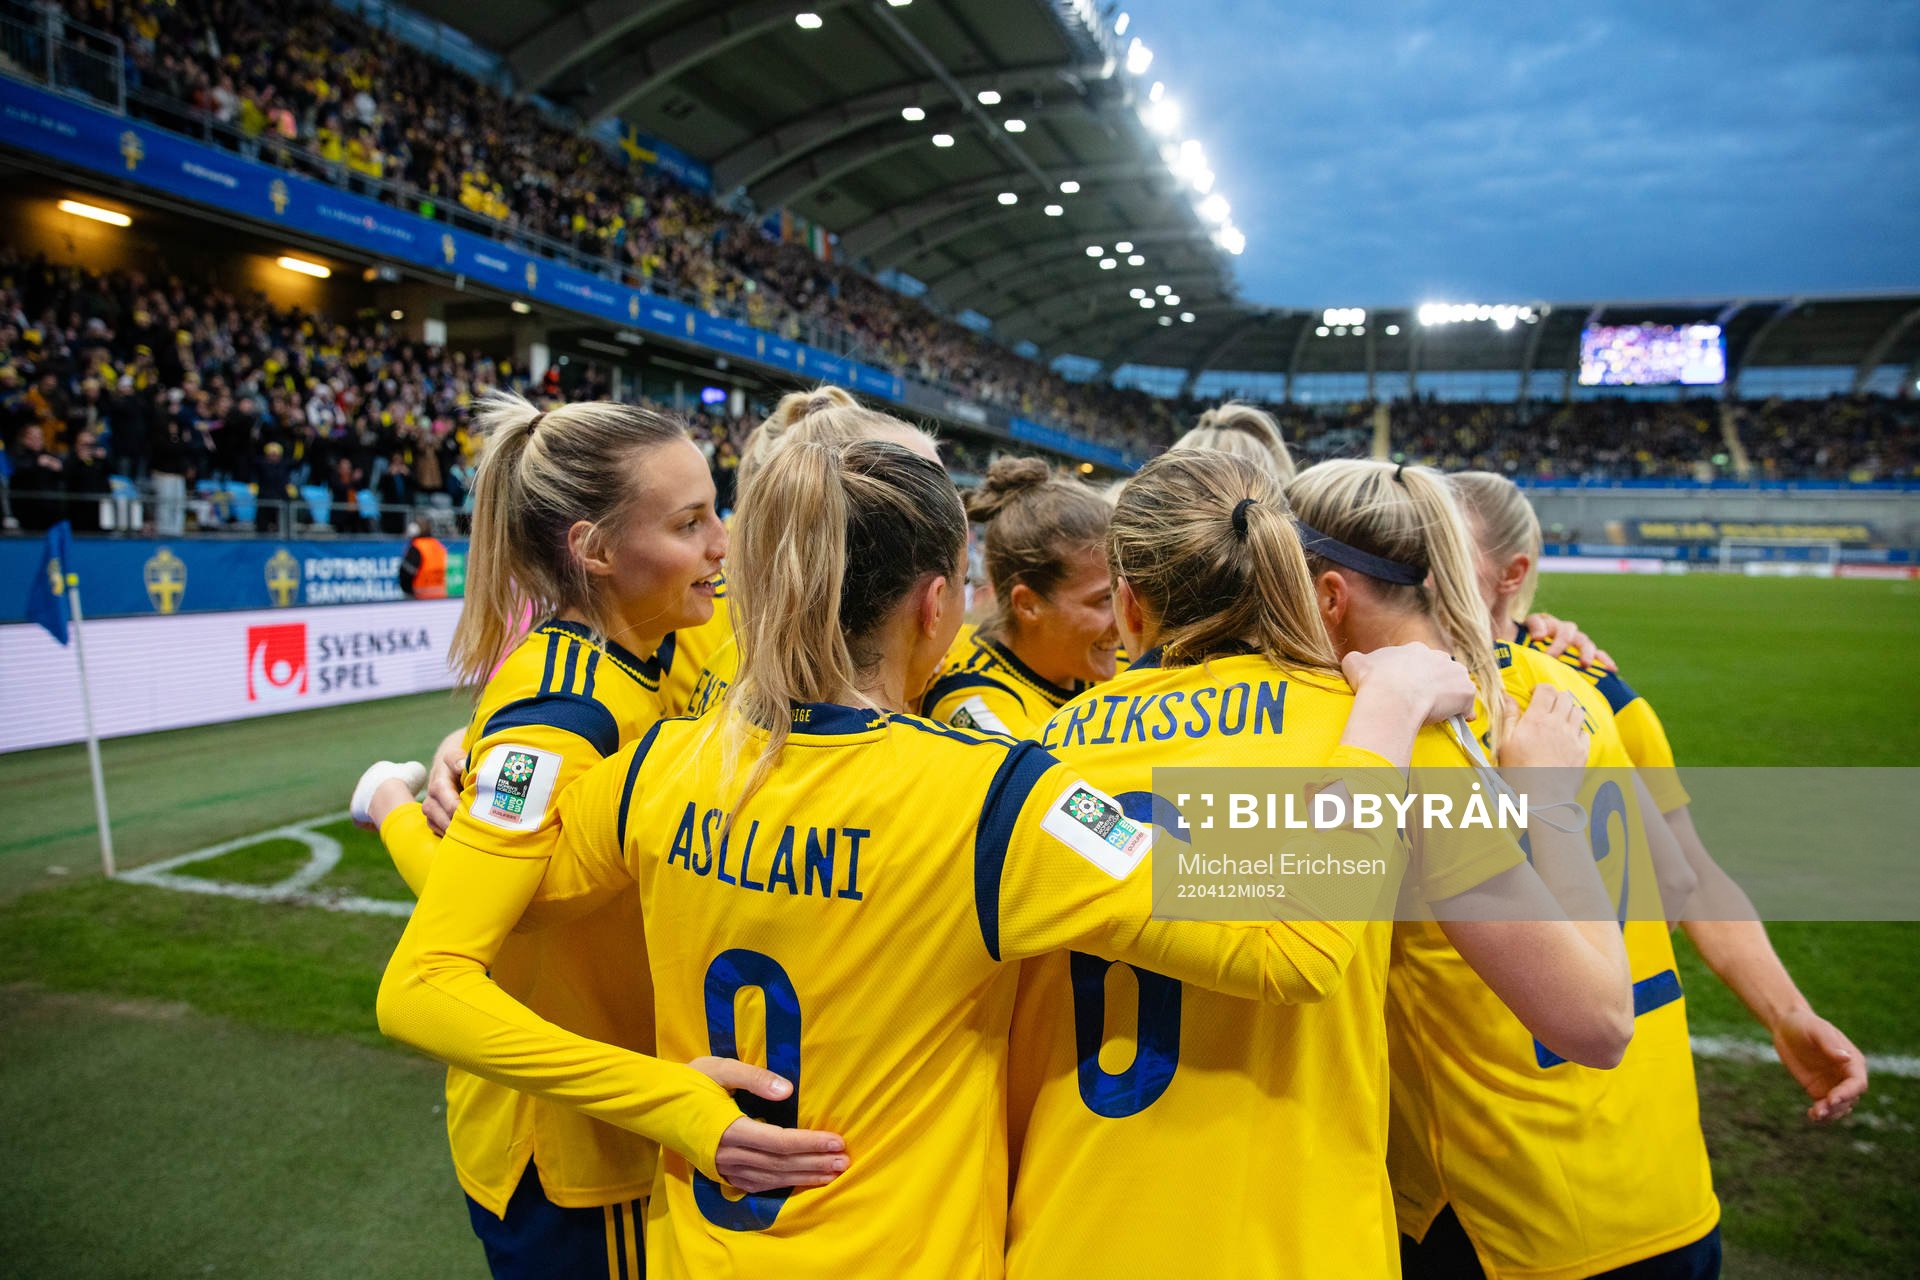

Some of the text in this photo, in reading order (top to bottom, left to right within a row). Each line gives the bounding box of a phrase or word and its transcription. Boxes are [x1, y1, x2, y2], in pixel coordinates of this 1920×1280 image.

[317, 628, 431, 663] SVENSKA
[318, 661, 380, 693] SPEL
[1041, 680, 1288, 750] ERIKSSON
[667, 801, 871, 901] ASLLANI
[693, 948, 801, 1232] 9
